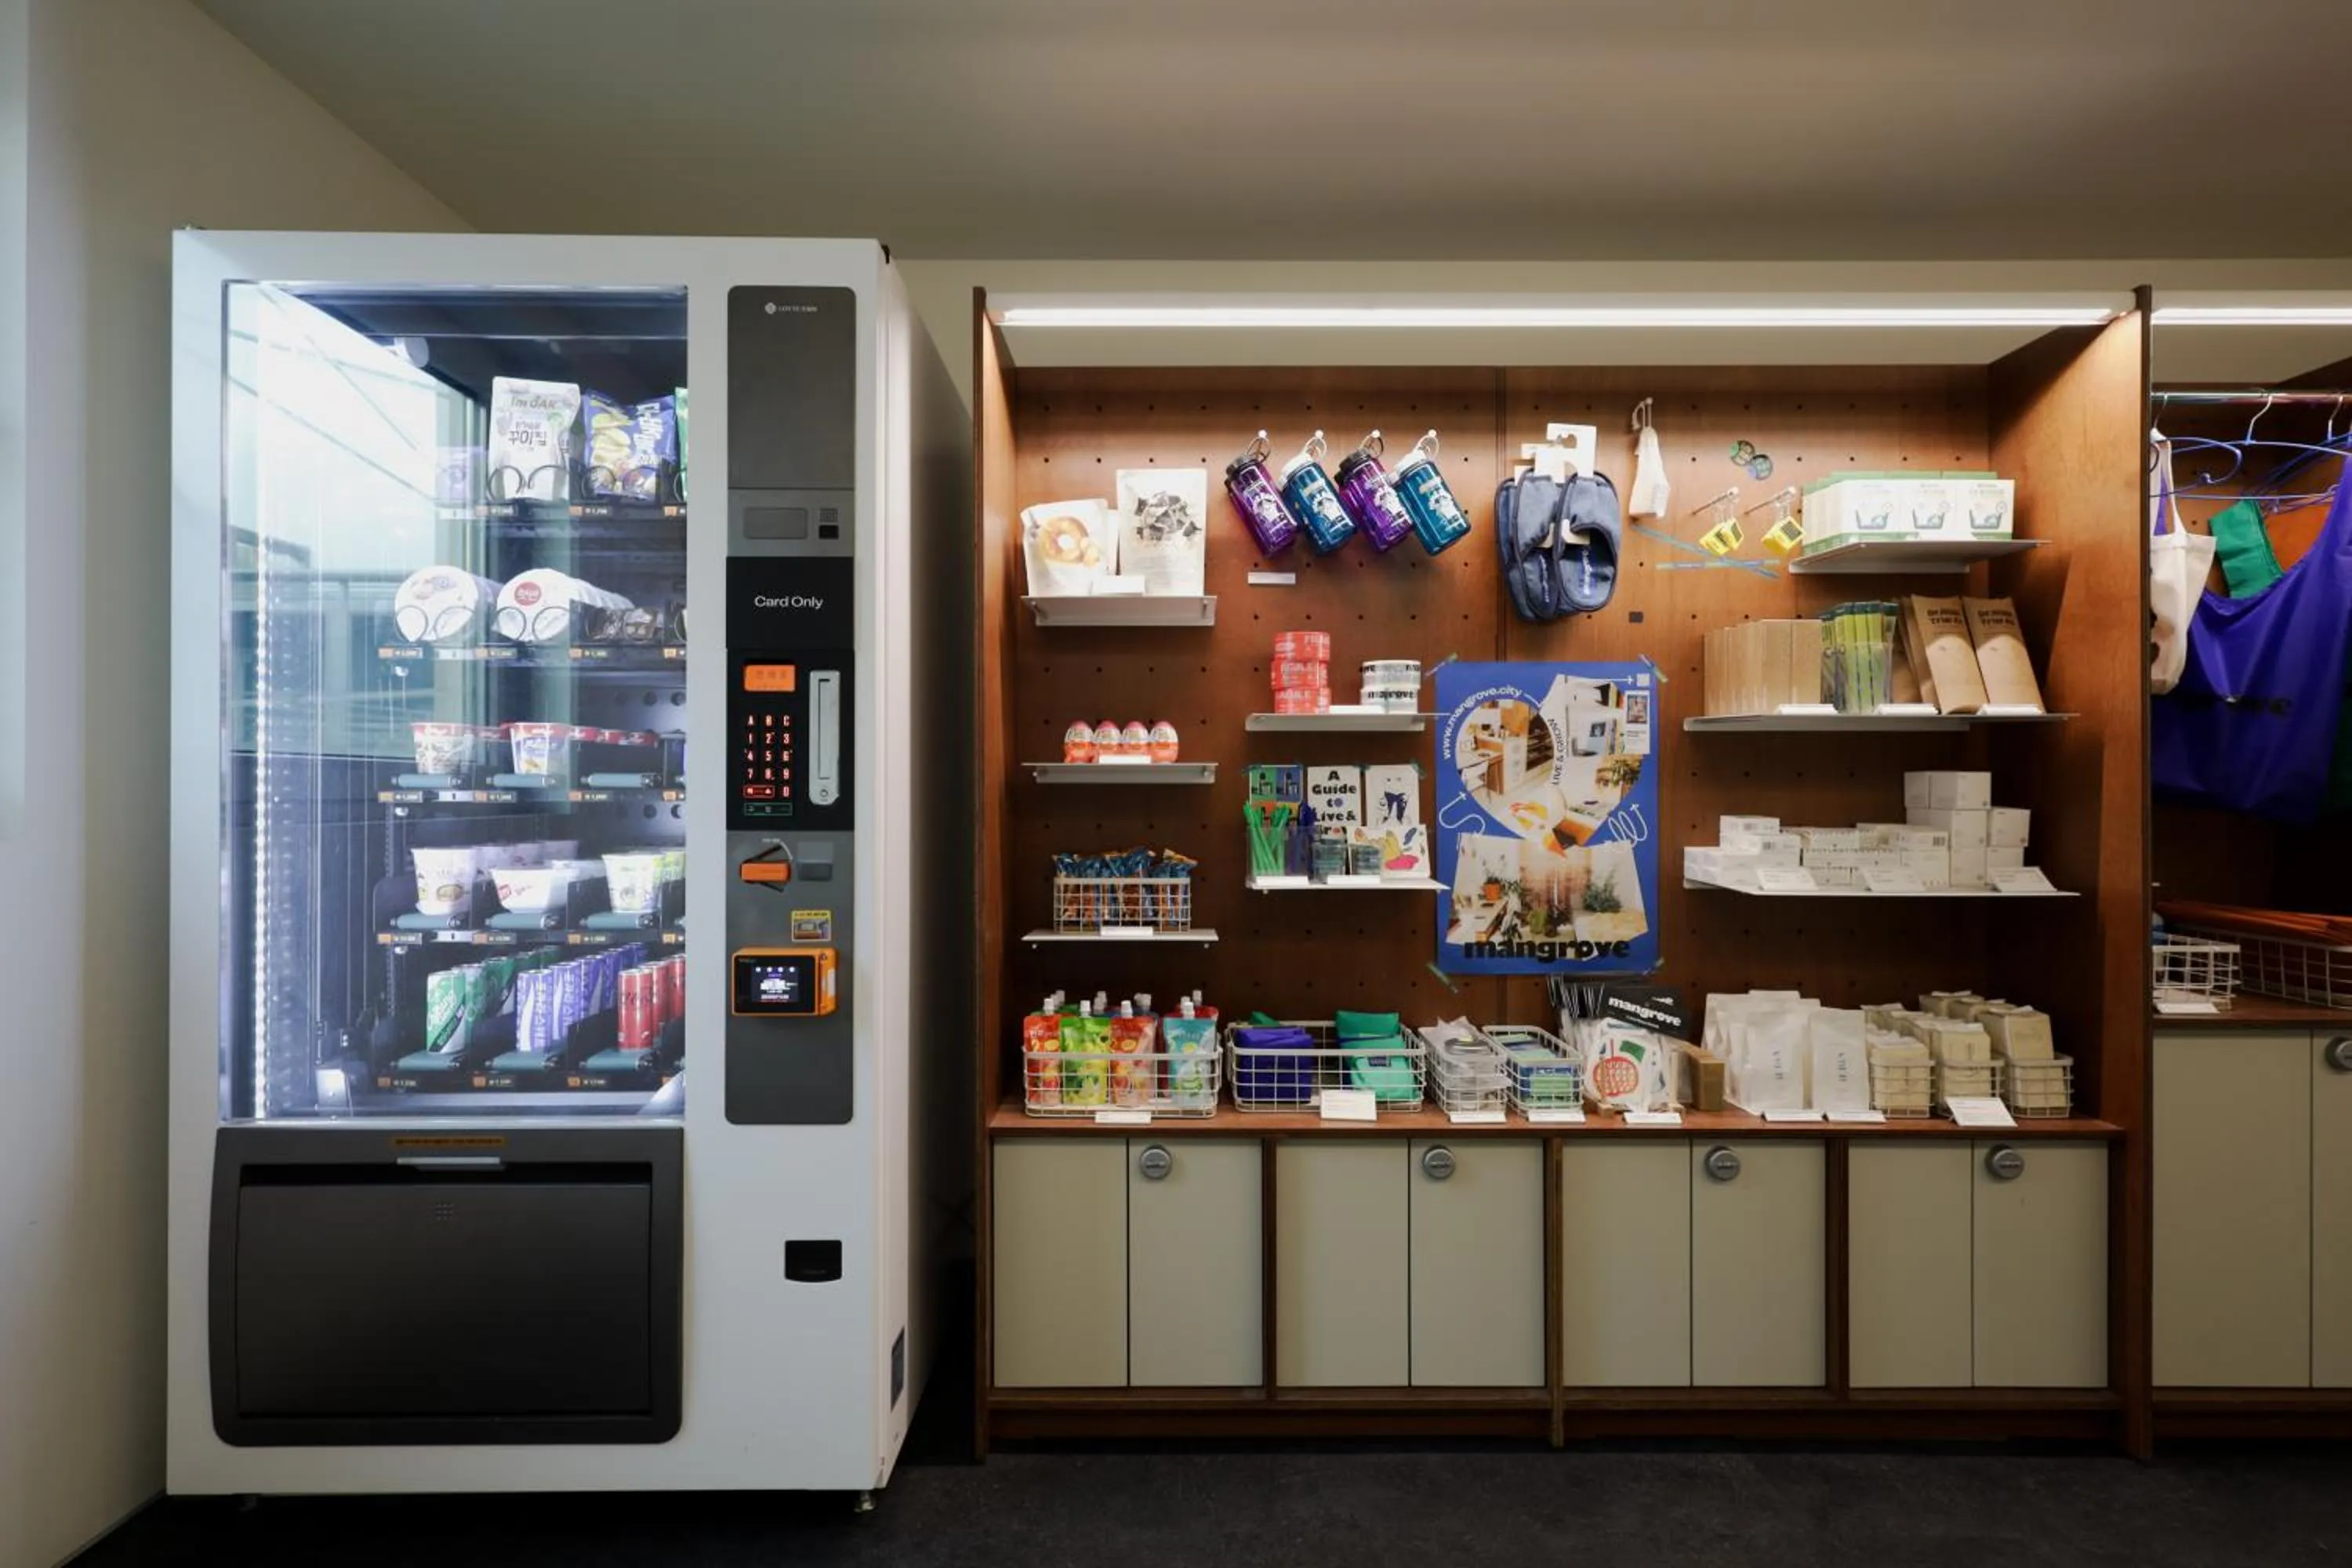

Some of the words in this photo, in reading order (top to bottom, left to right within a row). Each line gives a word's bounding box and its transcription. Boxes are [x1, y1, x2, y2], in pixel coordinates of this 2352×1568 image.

[754, 596, 789, 607] Card
[791, 596, 823, 609] Only
[747, 714, 754, 726] A
[784, 714, 789, 727] C
[749, 733, 753, 744] 1
[766, 733, 771, 744] 2
[784, 733, 789, 744] 3
[747, 750, 753, 761] 4
[765, 750, 771, 761] 5
[783, 750, 789, 761] 6
[747, 768, 753, 779] 7
[765, 768, 772, 779] 8
[784, 768, 789, 779] 9
[1328, 770, 1340, 781] A
[783, 786, 789, 797] 0
[1312, 784, 1356, 794] Guide
[1327, 798, 1343, 808] to
[1464, 940, 1630, 963] mangrove
[1608, 996, 1682, 1027] mangrove
